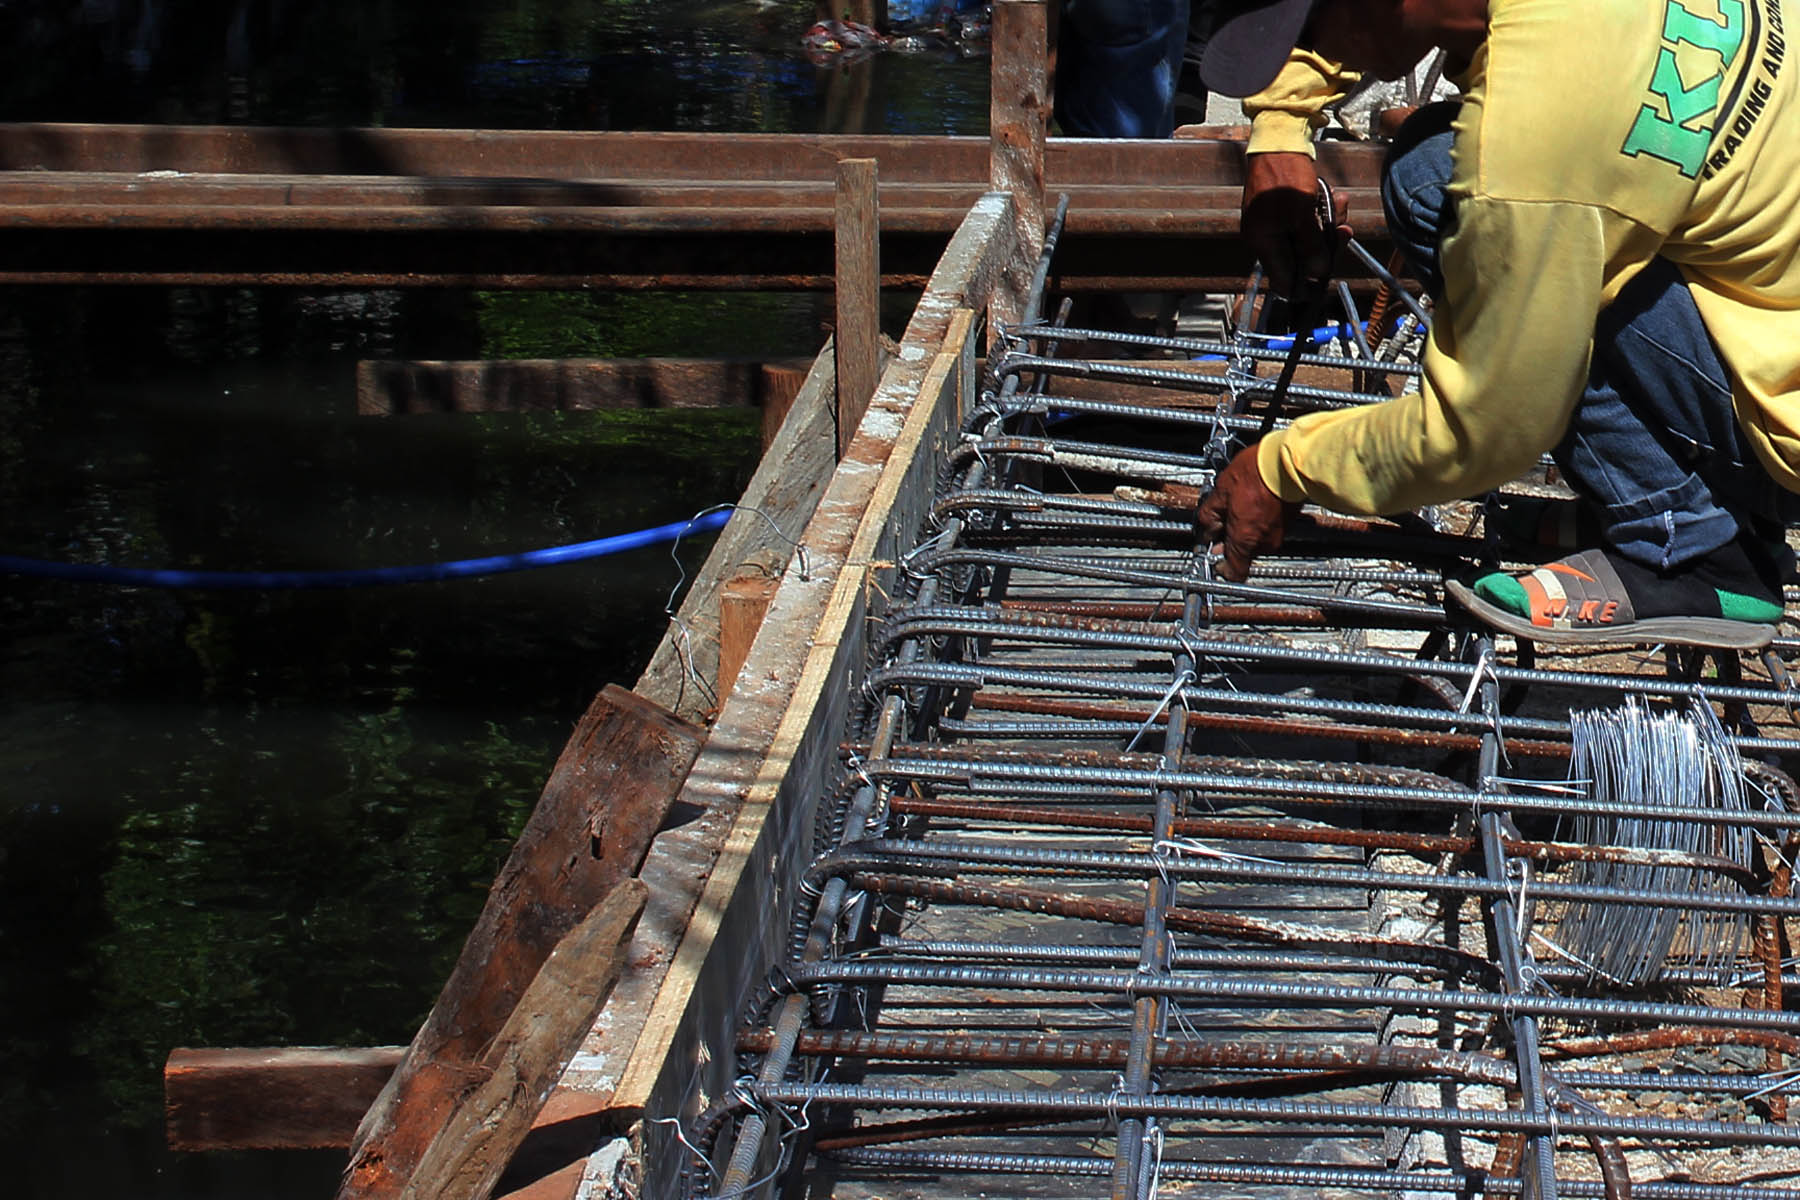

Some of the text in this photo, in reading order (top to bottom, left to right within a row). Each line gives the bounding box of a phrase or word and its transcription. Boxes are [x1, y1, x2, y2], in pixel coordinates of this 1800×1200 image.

[1700, 80, 1774, 181] TRADING
[1762, 30, 1787, 81] AND
[1543, 598, 1619, 623] NKE
